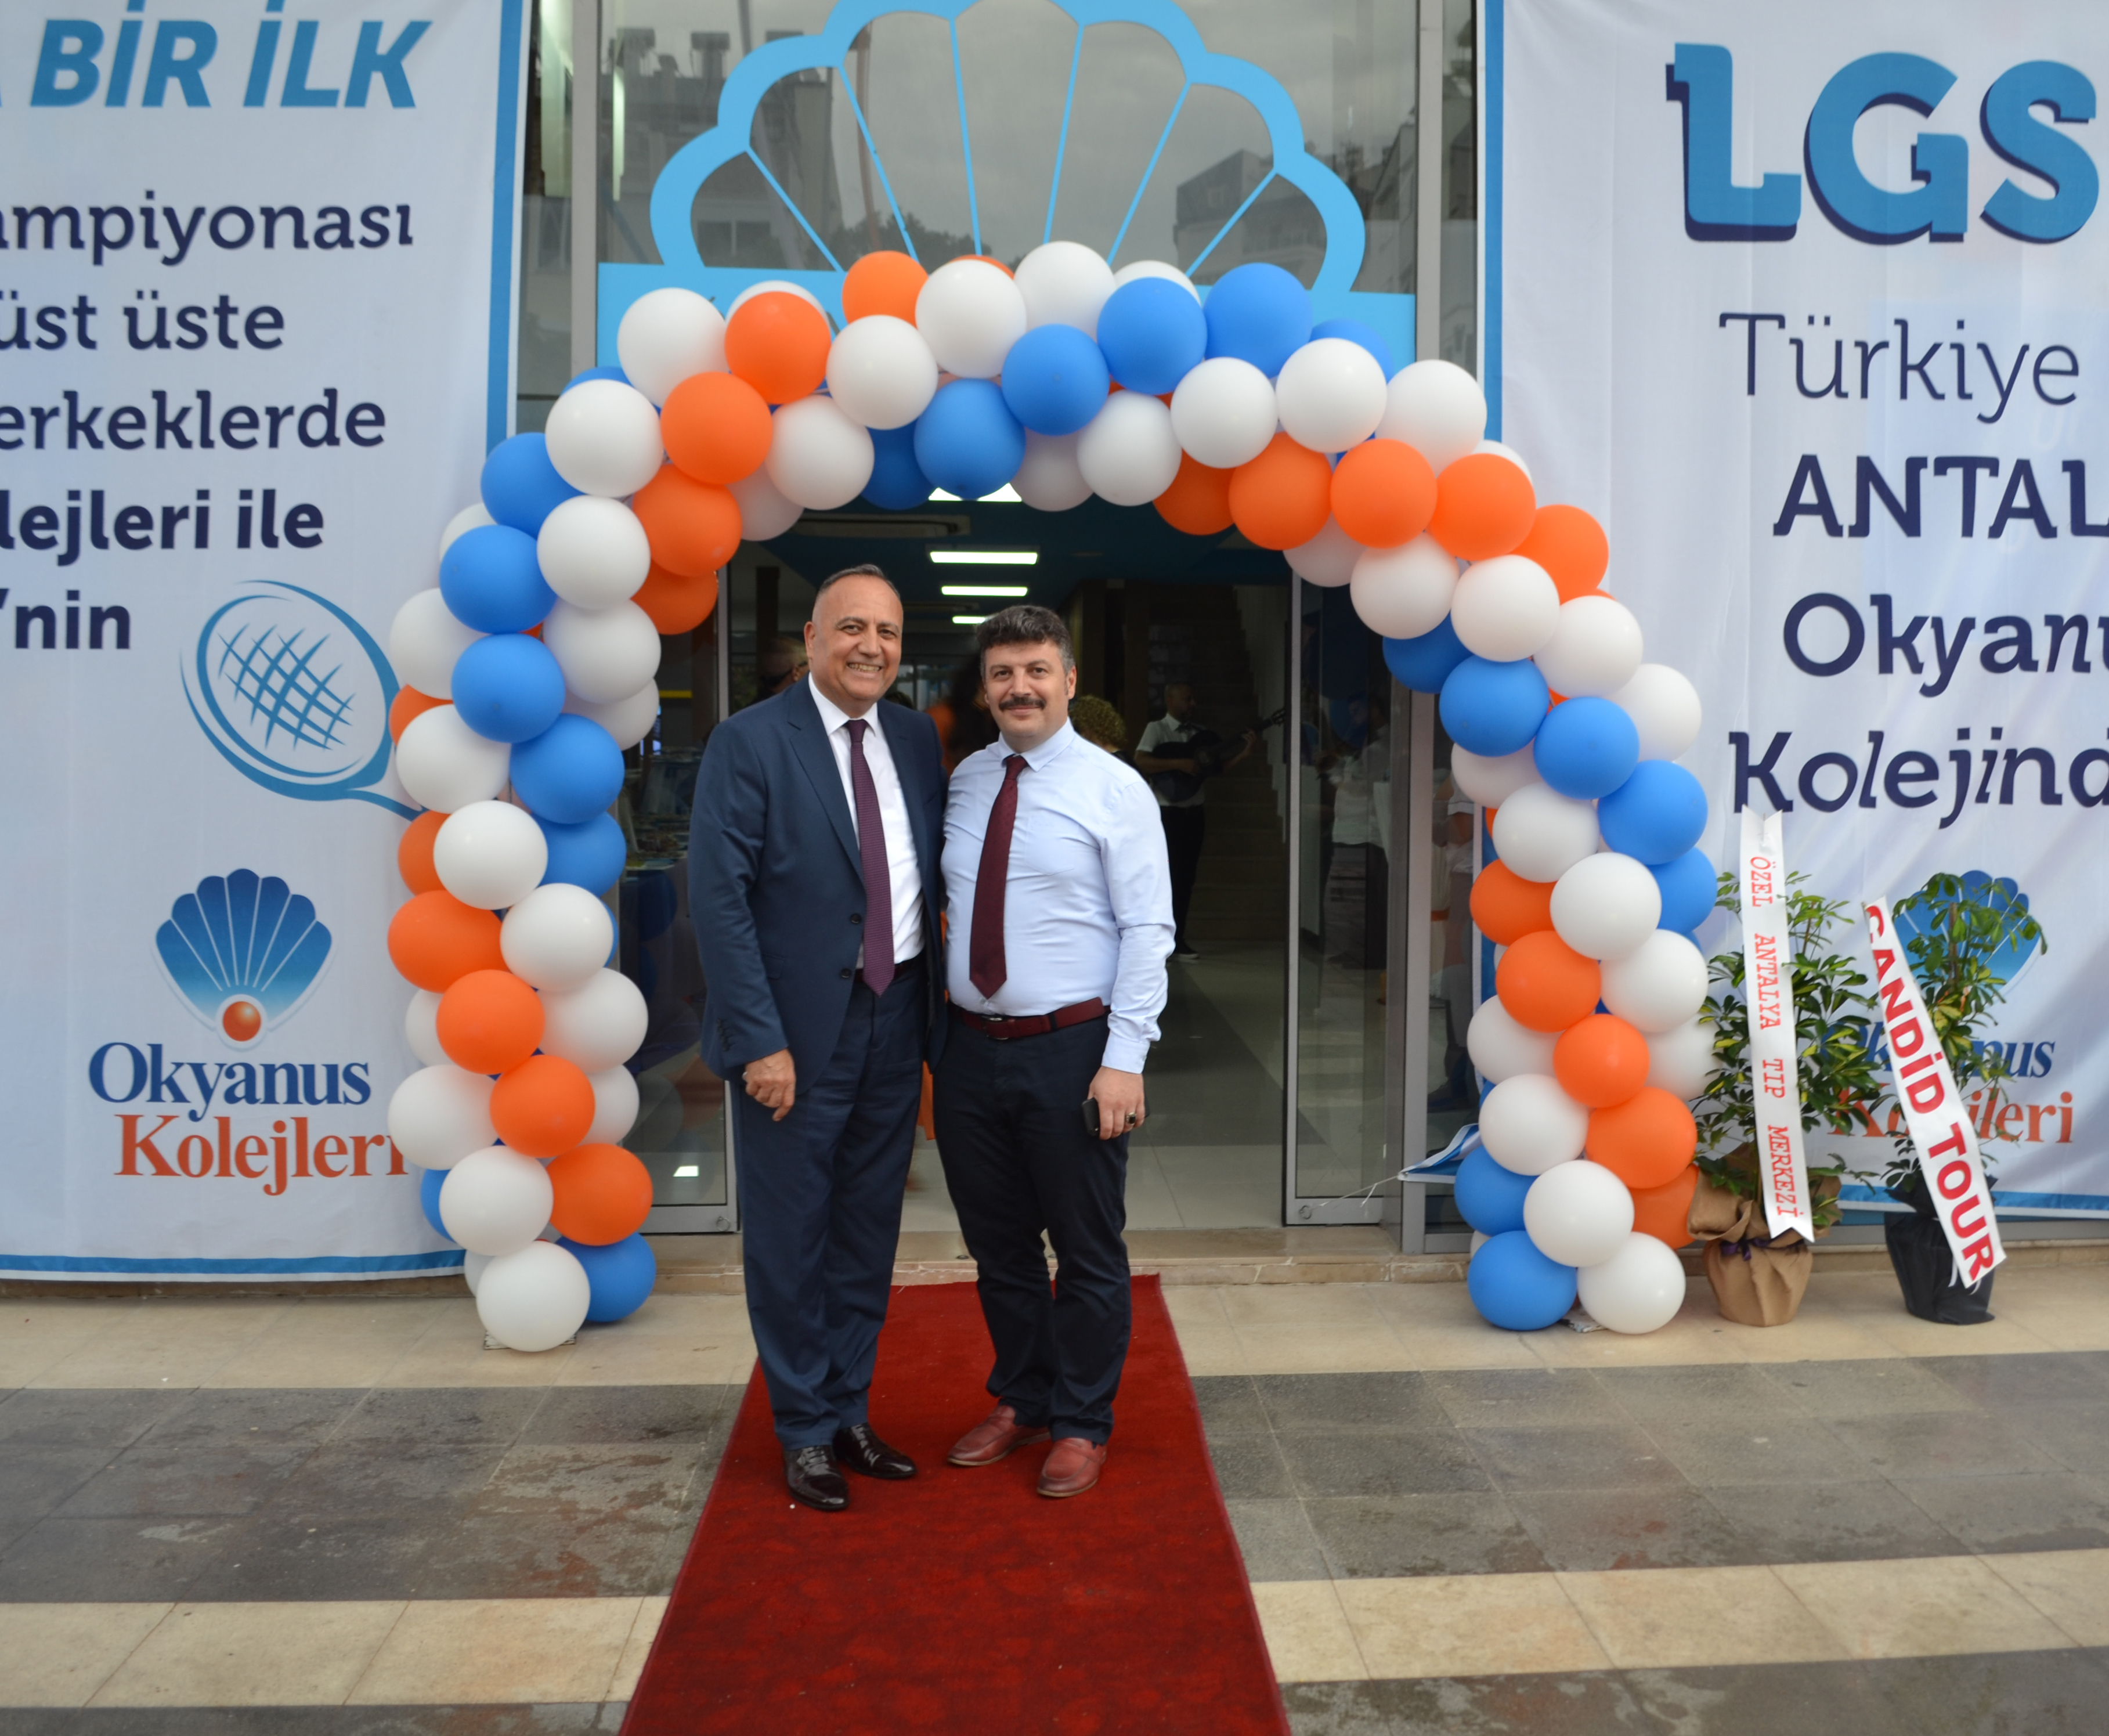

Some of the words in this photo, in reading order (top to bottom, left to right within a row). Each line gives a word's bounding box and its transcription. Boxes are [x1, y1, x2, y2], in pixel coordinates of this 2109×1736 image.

[30, 0, 218, 107] BİR
[243, 0, 432, 108] İLK
[1665, 42, 2100, 246] LGS
[0, 190, 413, 266] mpiyonası
[123, 290, 284, 351] üste
[1718, 312, 2079, 424] Türkiye
[237, 488, 324, 549] ile
[1773, 454, 2109, 539] ANTAL
[1783, 593, 2109, 698] Okyan
[1750, 856, 1776, 907] ÖZEL
[1754, 933, 1781, 1030] ANTALYA
[88, 1042, 371, 1123] Okyanus
[1762, 1058, 1786, 1099] TIP
[1767, 1124, 1804, 1218] MERKEZİ
[1927, 1121, 1994, 1282] TOUR
